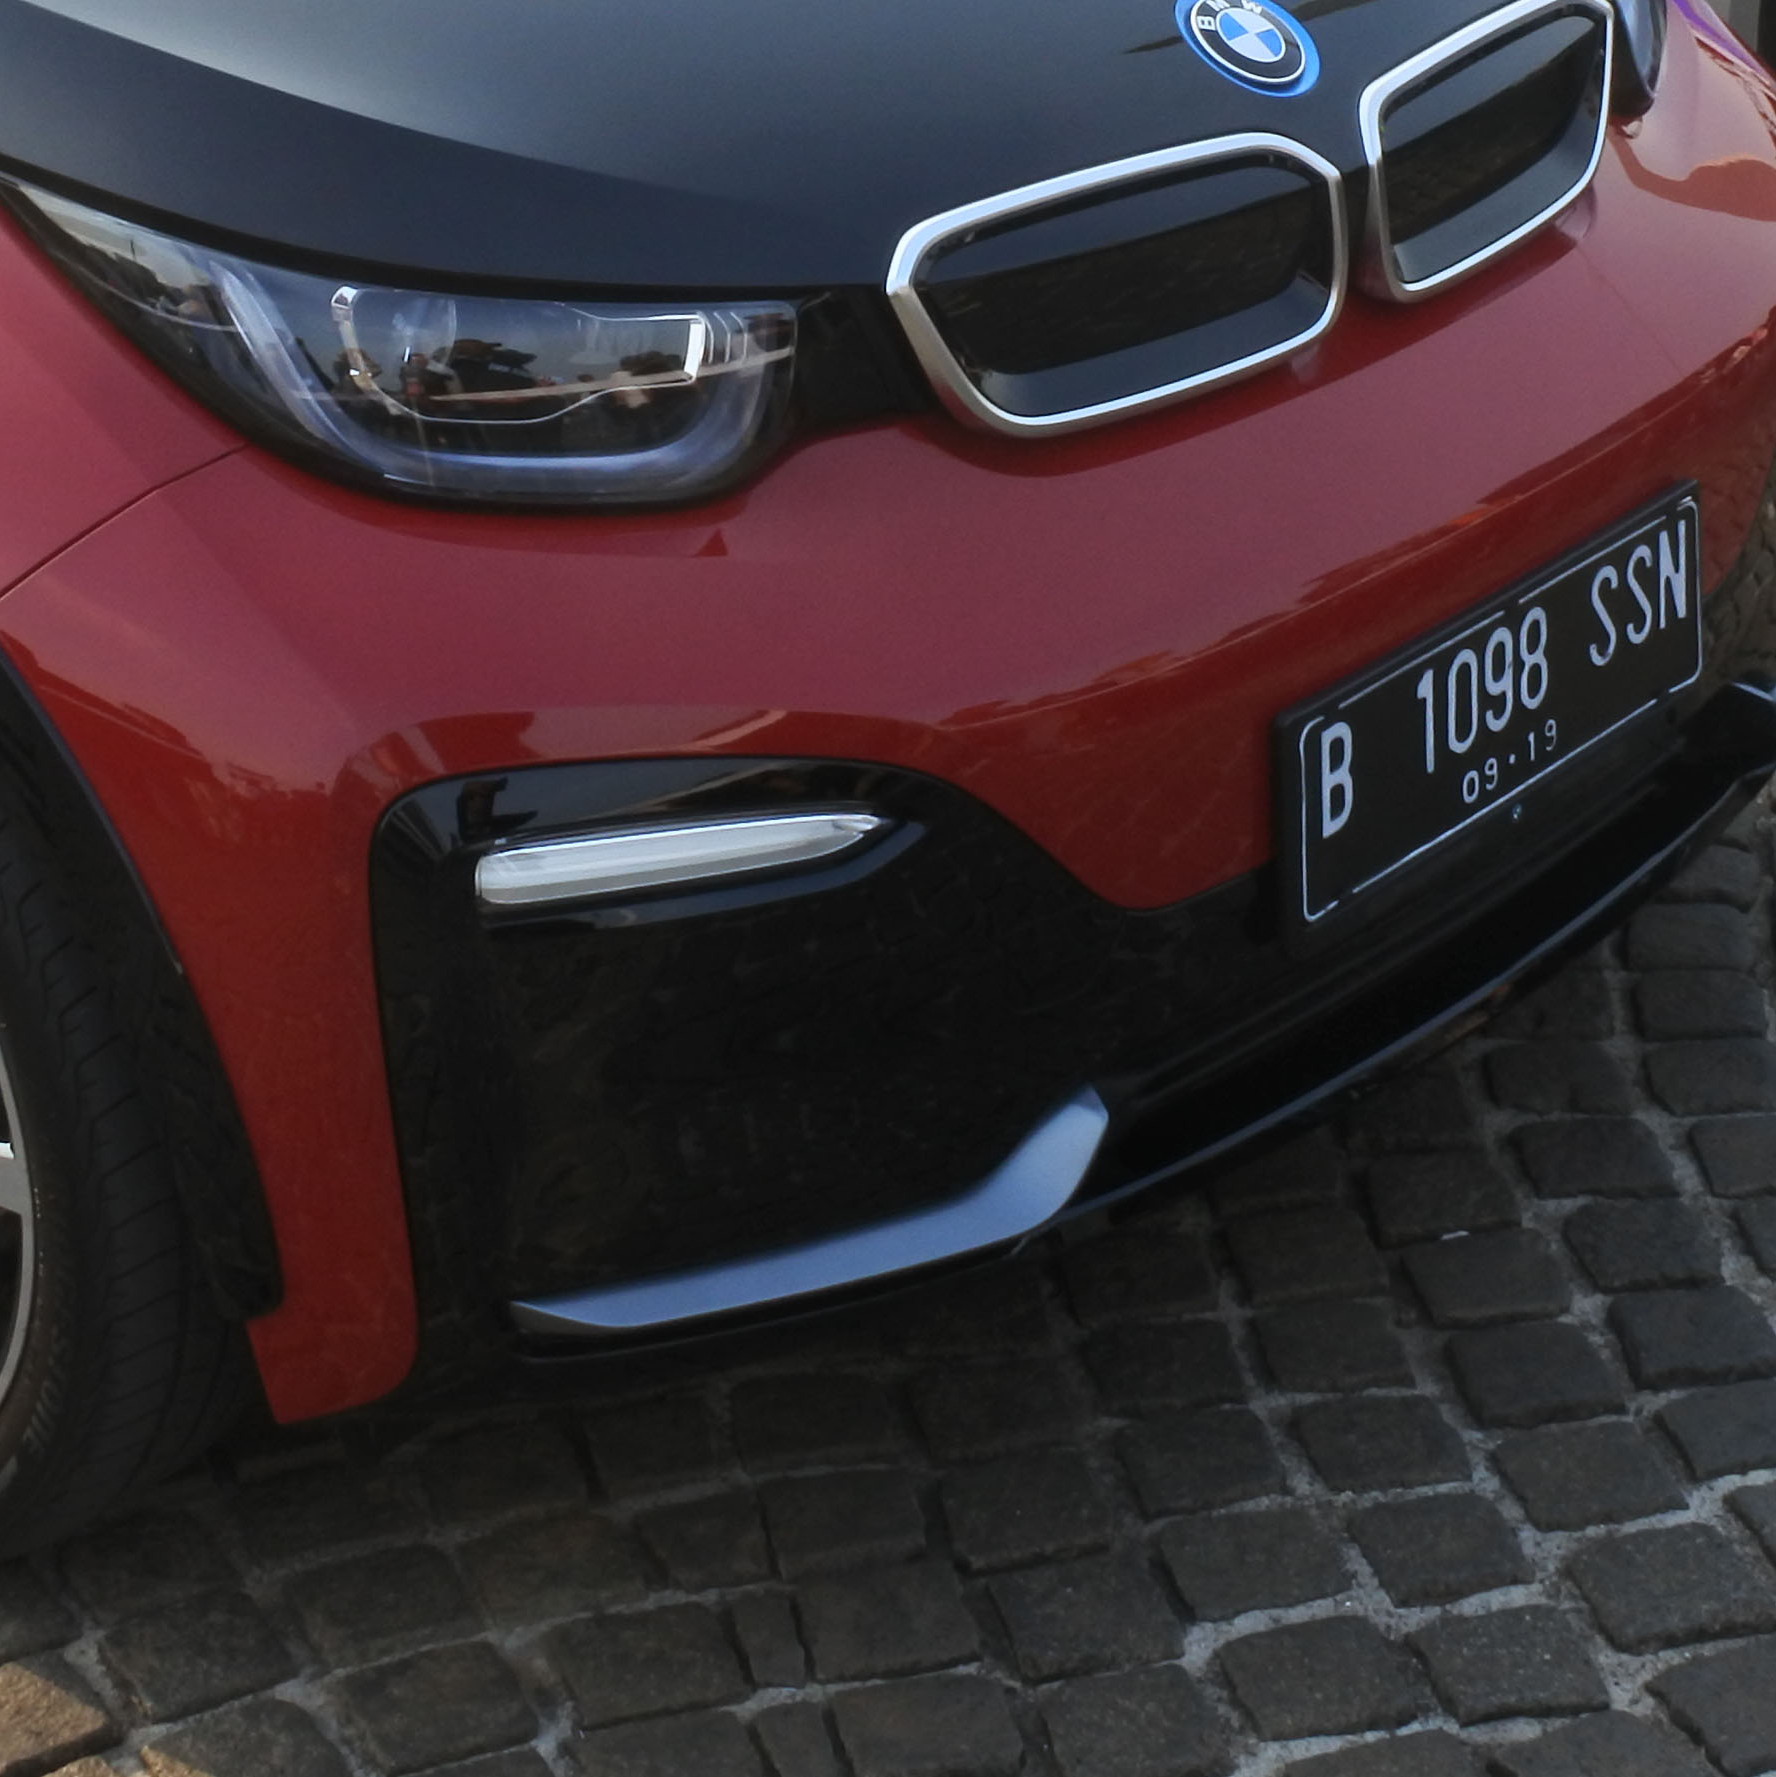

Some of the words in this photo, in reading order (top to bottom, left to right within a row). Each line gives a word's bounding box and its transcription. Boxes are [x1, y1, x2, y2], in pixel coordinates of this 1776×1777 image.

[1321, 720, 1354, 839] B
[1416, 605, 1548, 774] 1098
[1589, 519, 1687, 667] SSN
